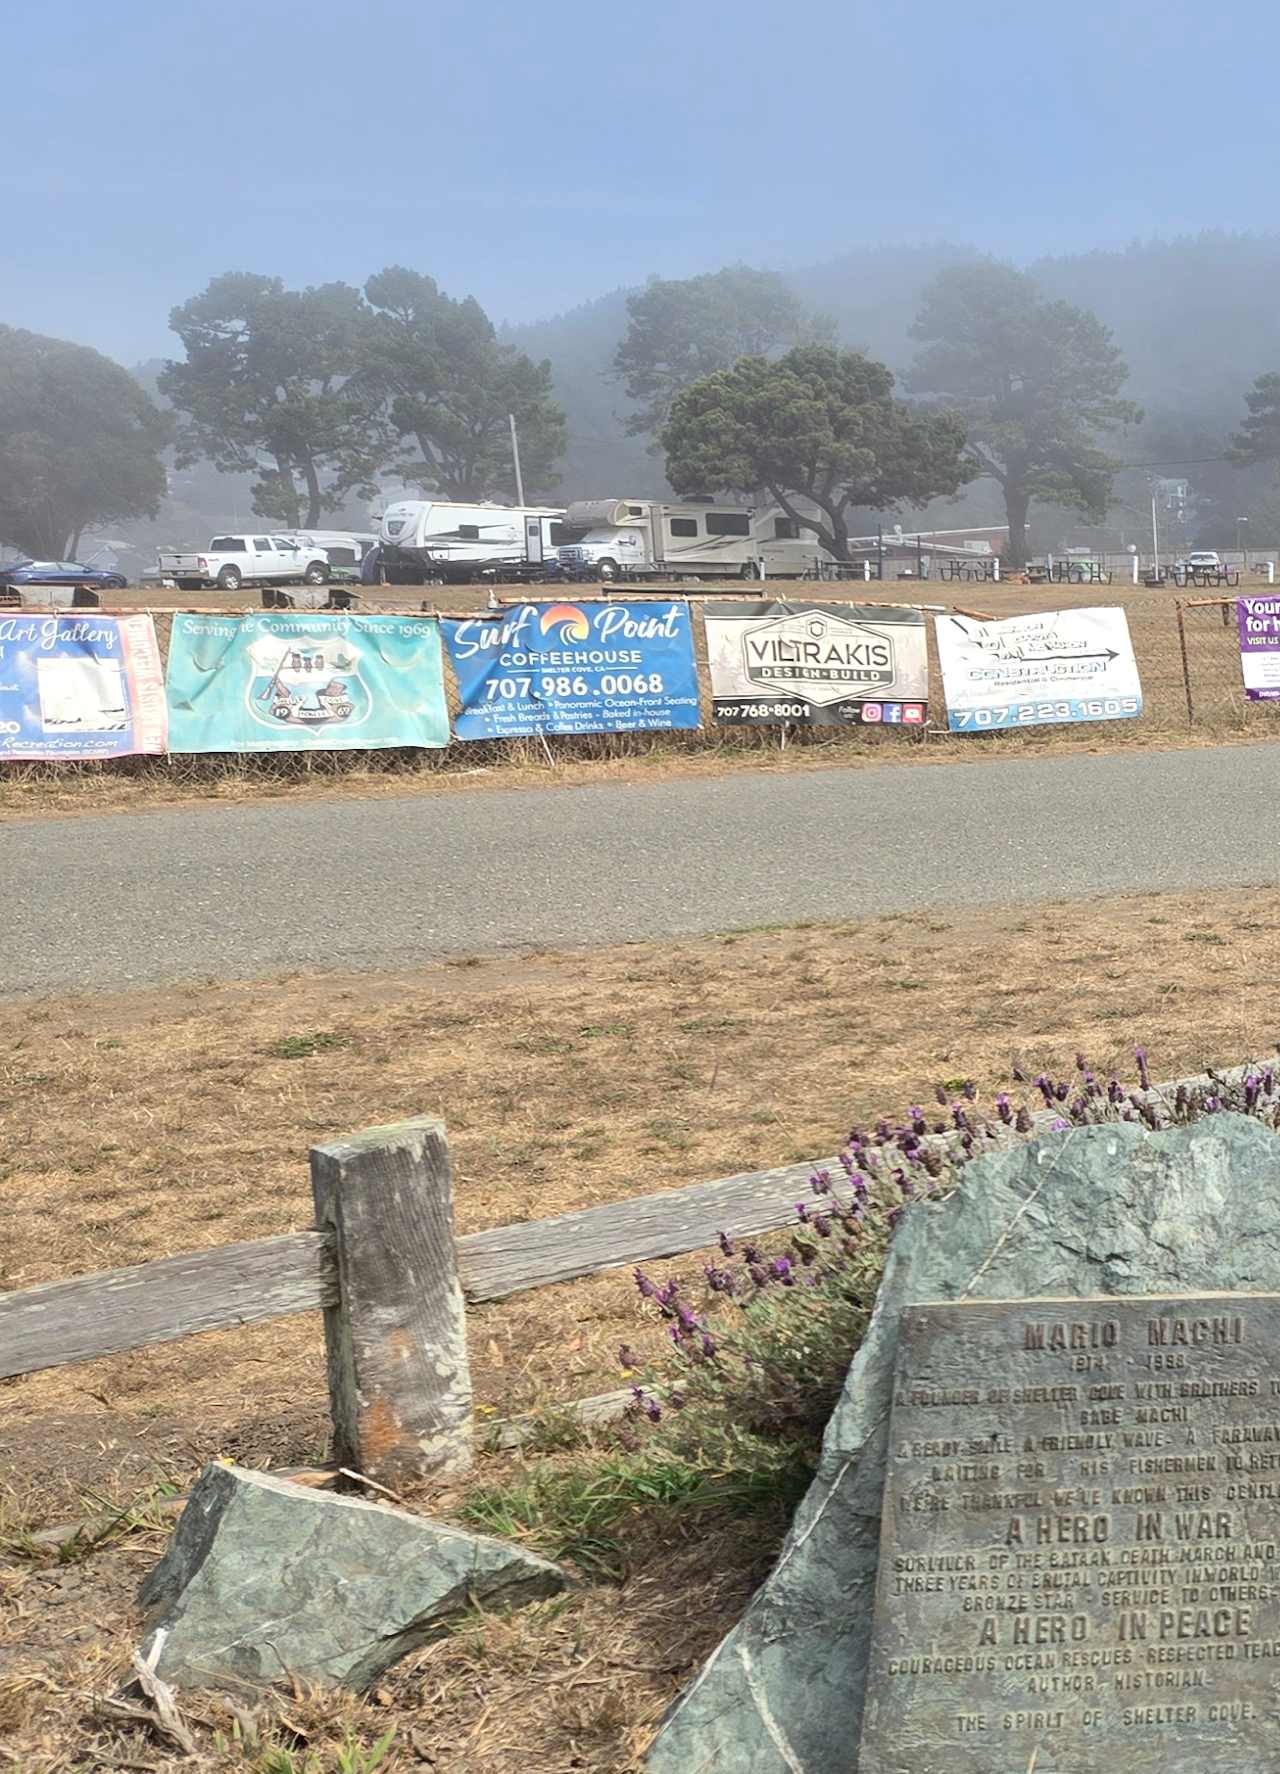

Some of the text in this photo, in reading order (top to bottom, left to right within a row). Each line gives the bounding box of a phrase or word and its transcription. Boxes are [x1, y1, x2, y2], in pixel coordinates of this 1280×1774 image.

[0, 618, 118, 650] Art Gallery
[182, 619, 236, 639] Serving
[257, 618, 349, 634] Community
[354, 619, 395, 634] Since
[399, 622, 432, 638] 1969
[454, 604, 686, 659] Surf Point
[1246, 616, 1269, 633] for
[500, 650, 643, 667] COFFEEHOUSE
[750, 638, 889, 666] VILTRAKIS
[486, 674, 664, 700] 707.986.0068
[517, 701, 545, 712] Lunch
[717, 707, 739, 717] 707
[954, 698, 1138, 728] 707.223.1605
[1024, 1317, 1245, 1350] MARIO MACHI
[1135, 1382, 1173, 1399] WITH
[1180, 1379, 1259, 1398] BROTHERS
[1080, 1460, 1110, 1476] HIS
[1129, 1456, 1217, 1474] FISHERMEN
[1176, 1484, 1213, 1502] THIS
[1006, 1511, 1234, 1546] A HERO IN WAR
[989, 1553, 1010, 1571] OF
[1015, 1552, 1042, 1569] THE
[1120, 1548, 1170, 1566] DEATH
[1180, 1546, 1235, 1563] MARCH
[1243, 1544, 1276, 1561] AND
[895, 1576, 945, 1593] THREE
[950, 1574, 1001, 1591] YEARS
[1007, 1573, 1026, 1590] OF
[1204, 1566, 1259, 1583] WORLD
[1033, 1593, 1074, 1610] STAR
[1101, 1589, 1170, 1607] SERVICE
[1182, 1587, 1199, 1604] TO
[978, 1608, 1251, 1646] A HERO IN PEACE
[888, 1655, 996, 1677] COURAGEOUS
[1004, 1654, 1055, 1672] OCEAN
[1062, 1648, 1132, 1668] RESCUES
[1027, 1676, 1094, 1694] AUTHOR
[956, 1714, 987, 1732] THE
[1003, 1711, 1064, 1730] SPIRIT
[1082, 1710, 1103, 1727] OF
[1123, 1706, 1197, 1726] SHELTER
